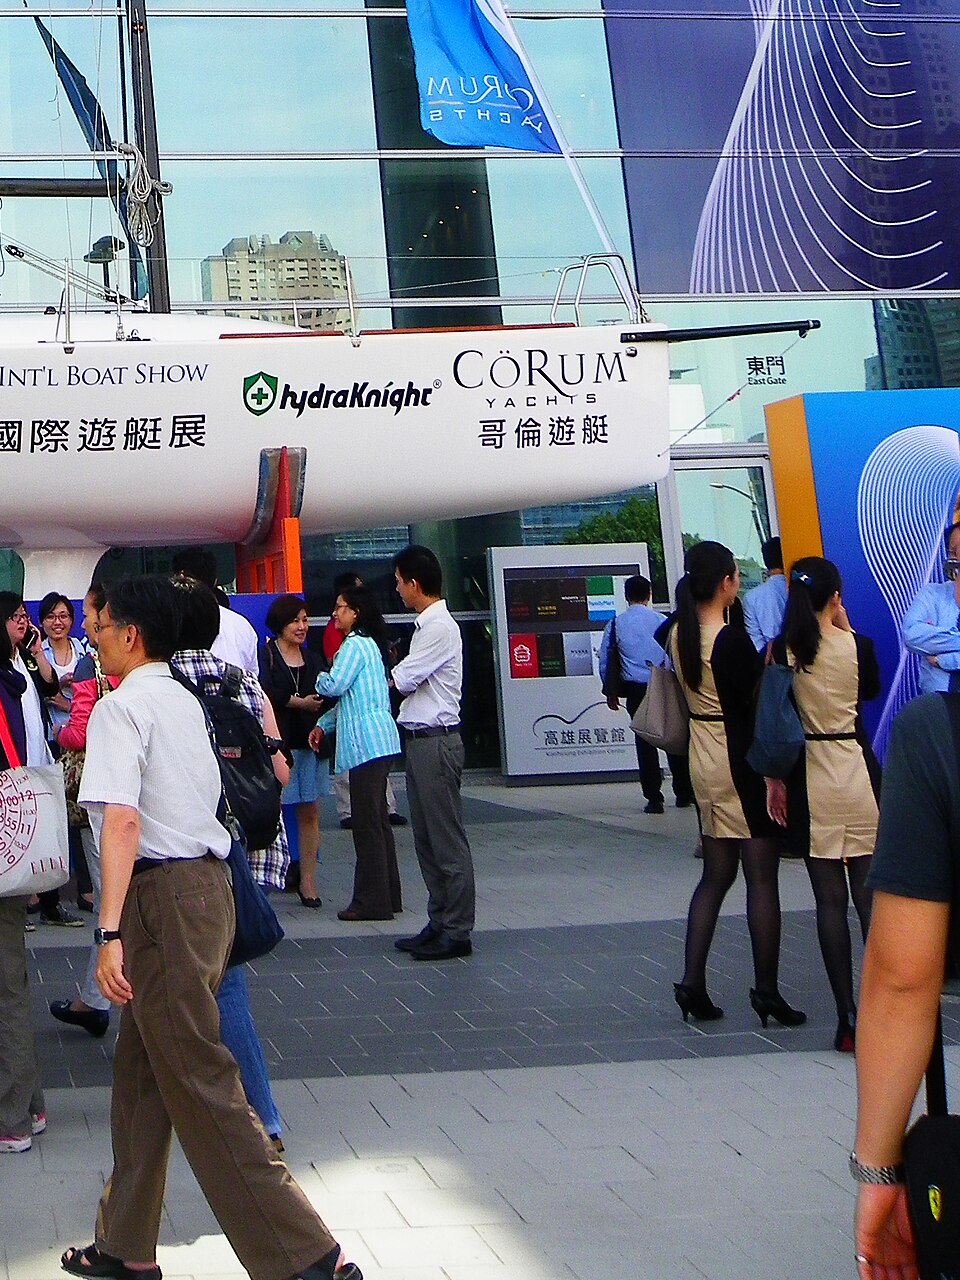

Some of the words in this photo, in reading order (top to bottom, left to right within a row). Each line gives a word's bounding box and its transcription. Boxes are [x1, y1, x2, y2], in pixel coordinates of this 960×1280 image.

[66, 365, 129, 386] BOAT
[134, 361, 210, 385] SHOW
[746, 356, 785, 375] 東門
[748, 377, 766, 385] East
[767, 376, 787, 385] Gate
[485, 393, 598, 408] YACHTS
[477, 415, 609, 450] 哥倫遊艇
